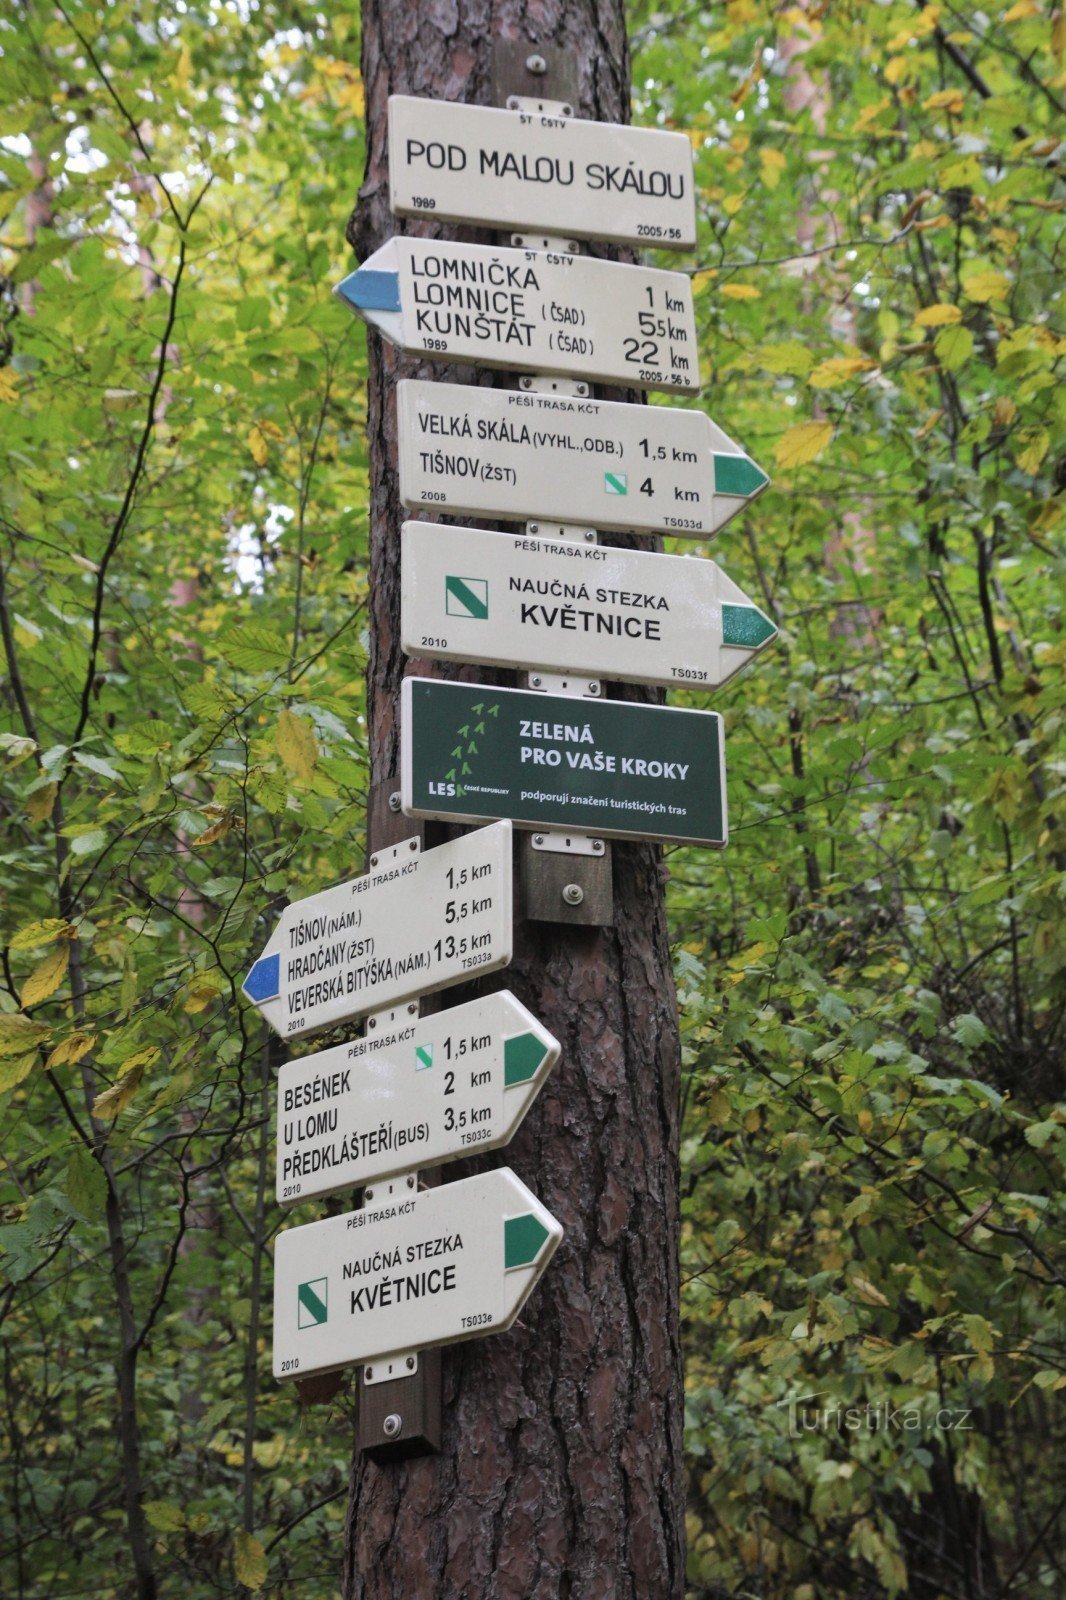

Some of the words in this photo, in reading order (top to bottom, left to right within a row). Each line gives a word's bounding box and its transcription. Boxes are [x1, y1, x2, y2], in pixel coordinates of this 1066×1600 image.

[407, 139, 467, 171] POD
[479, 148, 574, 186] MALOU
[586, 161, 685, 200] SKÁLOU
[411, 196, 436, 210] 1989
[410, 254, 541, 291] LOMNIČKA
[645, 286, 654, 308] 1
[665, 289, 685, 313] km
[413, 281, 526, 318] LOMNICE
[416, 309, 536, 347] KUNŠTÁT
[623, 338, 660, 366] 22
[670, 346, 690, 370] km
[422, 337, 448, 351] 1989
[536, 399, 575, 412] TRASA
[577, 403, 600, 415] KČT
[418, 412, 473, 438] VELKÁ
[638, 438, 667, 461] 1,5
[672, 448, 698, 464] km
[421, 490, 447, 502] 2008
[639, 477, 655, 498] 4
[674, 486, 700, 502] km
[663, 516, 703, 530] TS033d
[543, 544, 582, 558] TRASA
[585, 549, 608, 561] KČT
[509, 576, 590, 601] NAUČNÁ
[596, 588, 670, 612] STEZKA
[520, 603, 662, 641] KVĚTNICE
[421, 636, 448, 648] 2010
[671, 667, 709, 681] TS033f
[519, 720, 595, 745] ZELENÁ
[521, 746, 562, 767] PRO
[565, 750, 617, 773] VAŠE
[621, 757, 690, 781] KROKY
[520, 790, 569, 805] podporují
[571, 795, 609, 808] značení
[610, 798, 667, 815] turistických
[667, 804, 688, 816] tras
[372, 869, 400, 887] TRASA
[401, 861, 419, 876] KČT
[445, 867, 468, 890] 1,5
[471, 863, 492, 881] km
[445, 901, 468, 924] 5,5
[472, 897, 492, 915] km
[287, 970, 344, 1015] VEVERSKÁ
[434, 935, 467, 962] 13,5
[471, 930, 492, 950] km
[462, 952, 492, 970] TS033a
[287, 1017, 305, 1032] 2010
[368, 1034, 397, 1052] TRASA
[398, 1027, 416, 1043] KČT
[443, 1037, 467, 1061] 1,5
[471, 1033, 492, 1051] km
[284, 1069, 351, 1112] BESÉNEK
[443, 1071, 455, 1096] 2
[471, 1069, 492, 1088] km
[284, 1123, 293, 1146] U
[297, 1107, 338, 1142] LOMU
[443, 1107, 467, 1132] 3,5
[471, 1106, 492, 1125] km
[460, 1129, 492, 1146] TS033c
[283, 1183, 302, 1198] 2010
[368, 1207, 397, 1224] TRASA
[398, 1200, 416, 1216] KČT
[342, 1245, 402, 1280] NAUČNÁ
[406, 1233, 464, 1264] STEZKA
[350, 1264, 457, 1315] KVĚTNICE
[461, 1313, 493, 1329] TS033e
[281, 1358, 300, 1372] 2010
